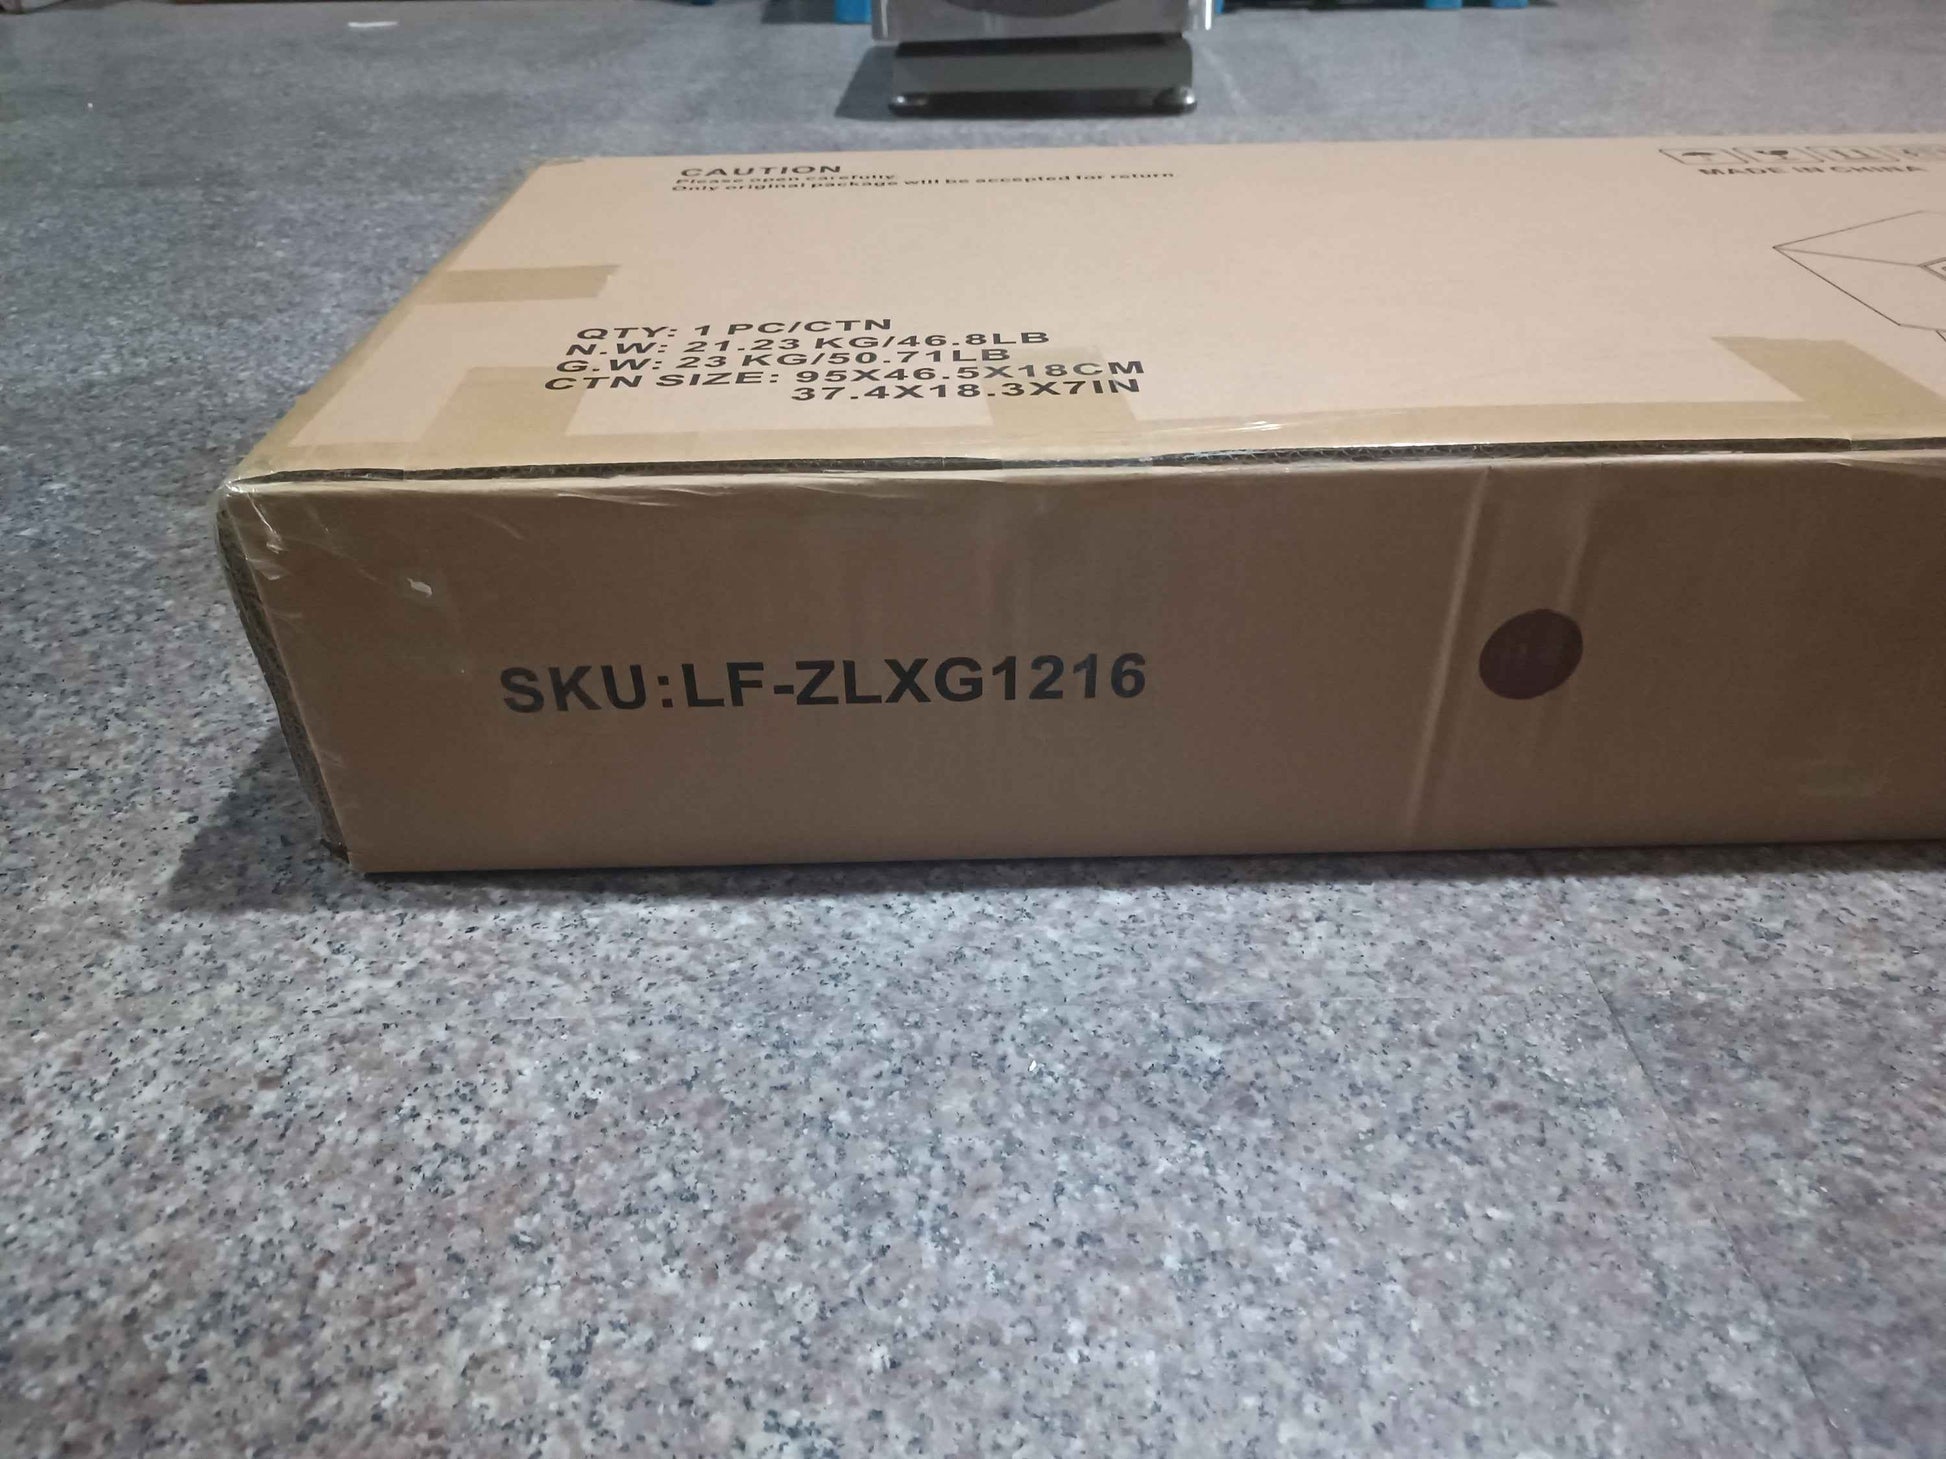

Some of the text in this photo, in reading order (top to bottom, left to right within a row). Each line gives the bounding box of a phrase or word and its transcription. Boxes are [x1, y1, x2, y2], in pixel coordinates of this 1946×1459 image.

[681, 166, 841, 177] CAUTION
[976, 175, 1070, 183] accepted
[1698, 167, 1787, 175] MADE
[1830, 165, 1928, 173] CHINA
[576, 319, 891, 340] QTY: 1 PC/CTN
[565, 332, 1049, 356] N.W: 21.23 KG/46.8LB
[556, 348, 1010, 372] G.W: 23 KG/50.71LB
[545, 360, 1145, 390] CTN SIZE: 95X46.5X18CM
[791, 378, 1140, 401] 37.4X18.3X7IN
[501, 652, 1146, 713] SKU:LF-ZLXG1216
